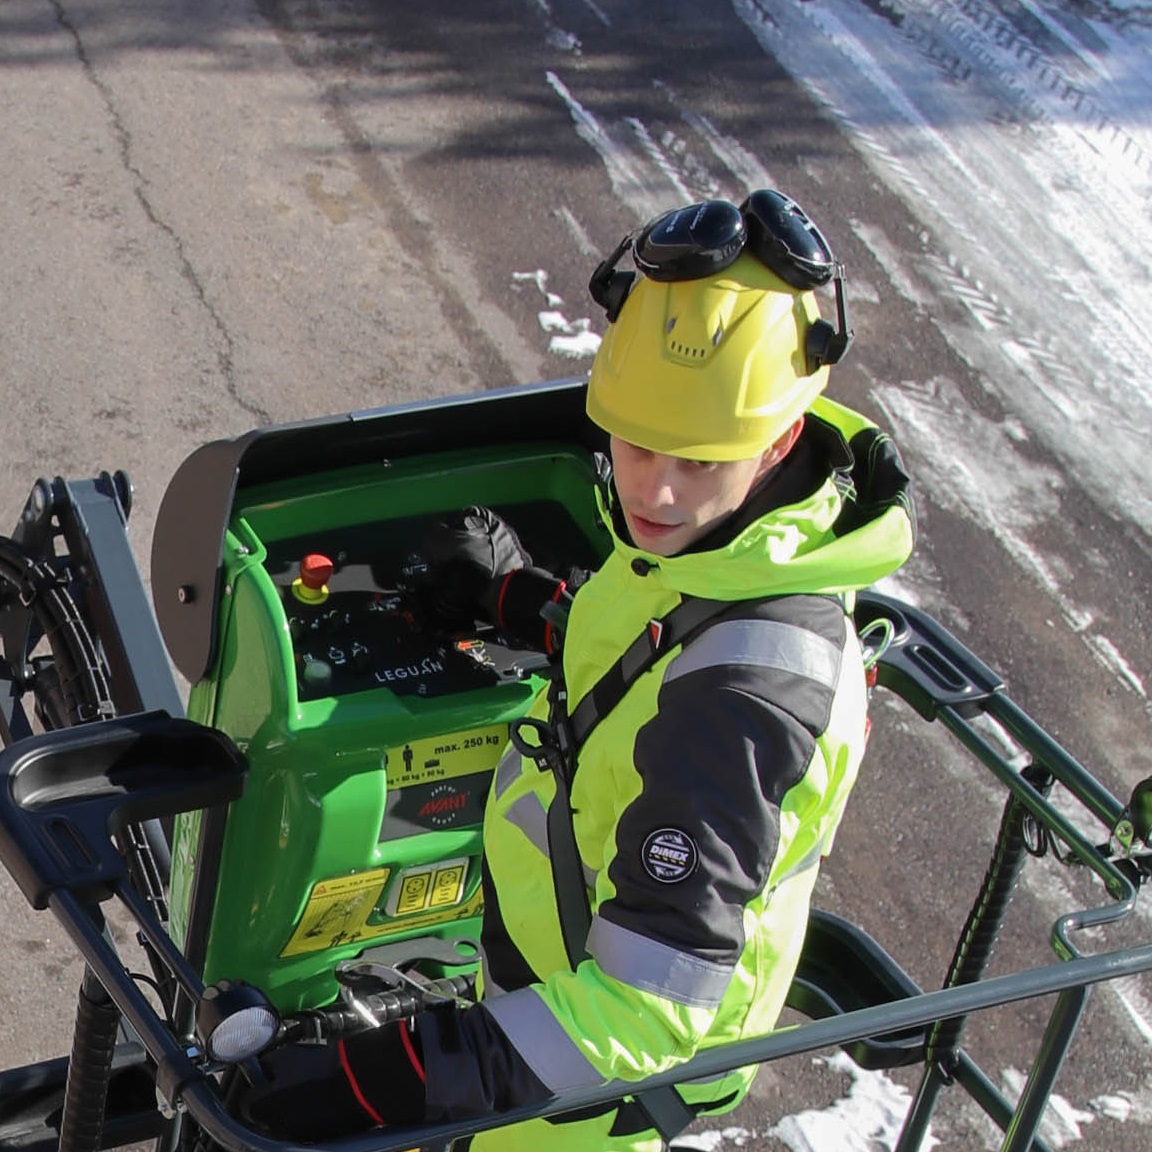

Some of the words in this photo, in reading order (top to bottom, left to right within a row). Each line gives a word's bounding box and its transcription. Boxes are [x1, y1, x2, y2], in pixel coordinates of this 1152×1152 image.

[374, 657, 444, 683] LEGUAN
[434, 744, 461, 754] max.
[464, 737, 483, 748] 250
[486, 735, 499, 745] kg
[418, 790, 467, 816] AVANT
